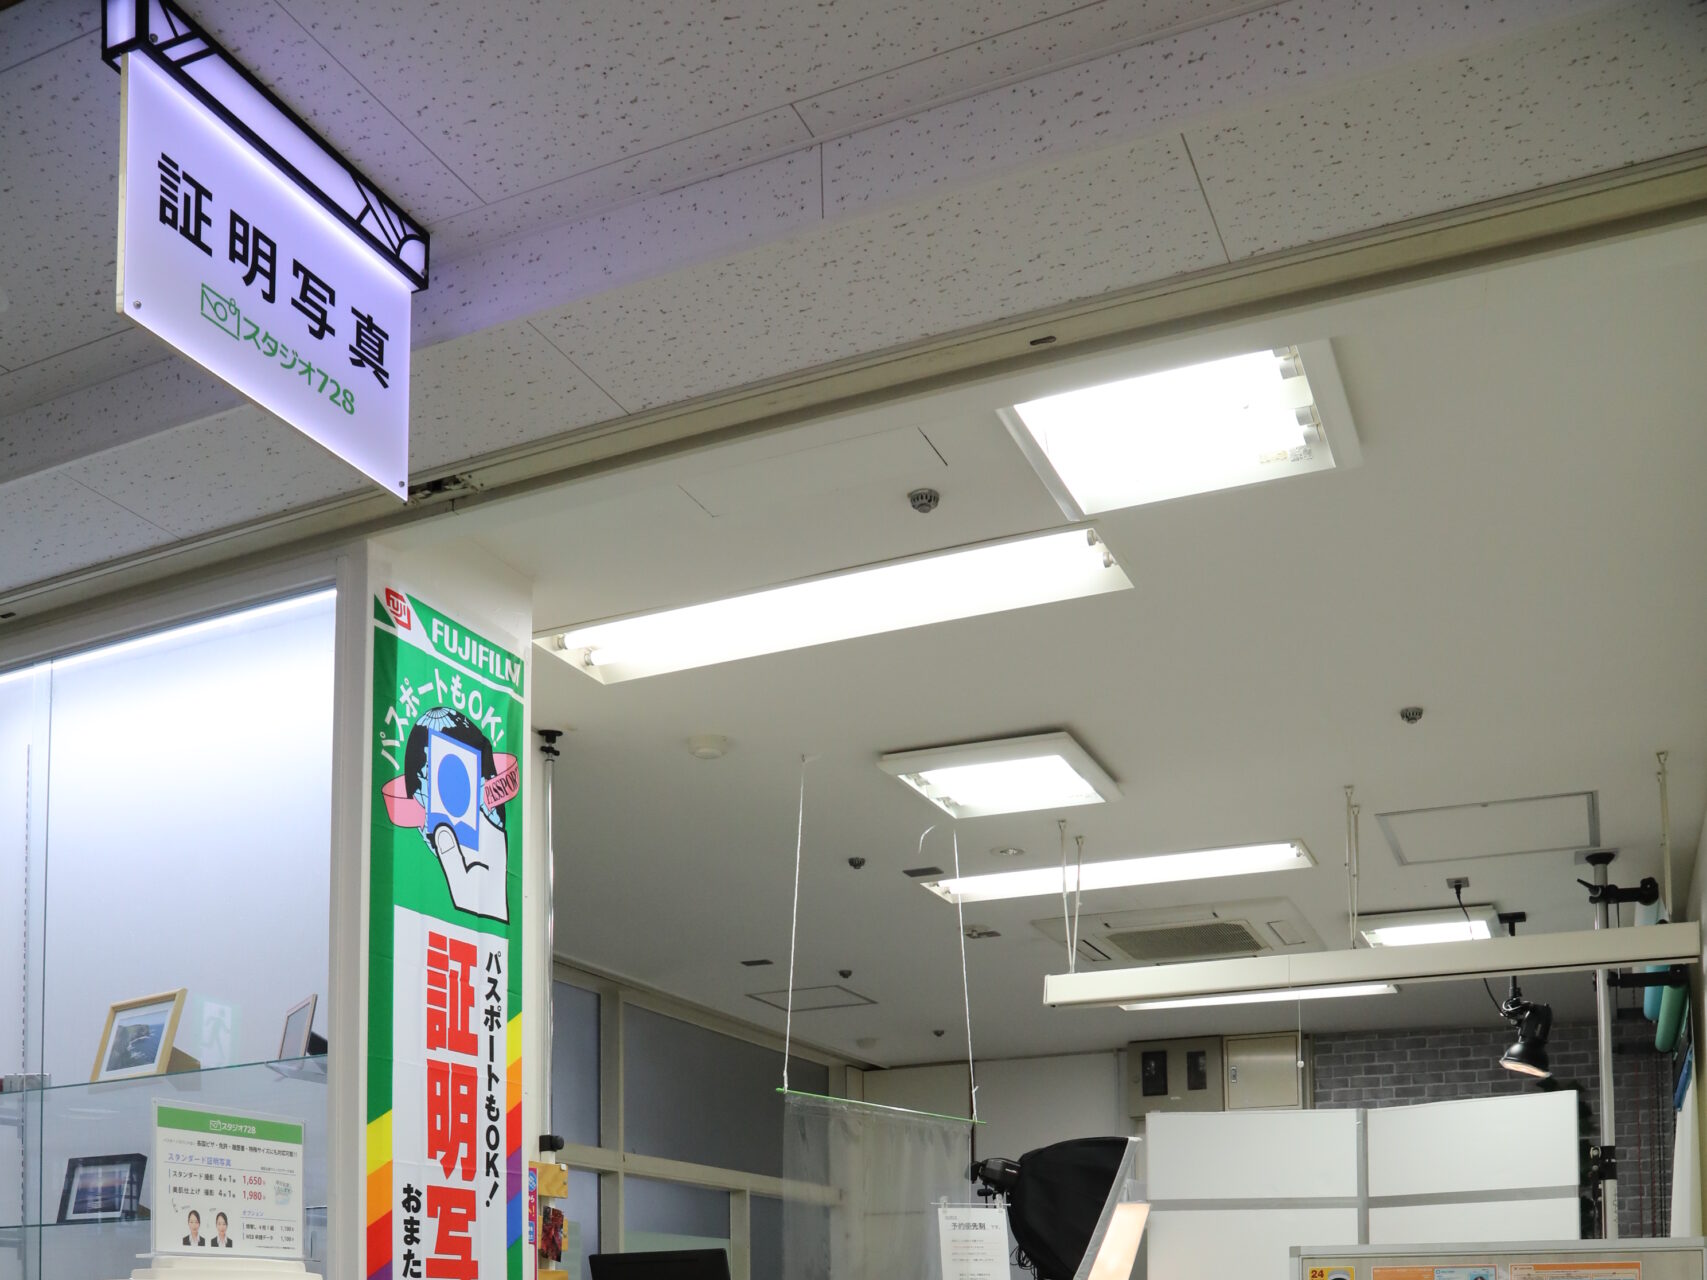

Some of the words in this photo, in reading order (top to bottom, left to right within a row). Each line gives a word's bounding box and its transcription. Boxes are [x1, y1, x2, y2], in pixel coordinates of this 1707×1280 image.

[158, 152, 390, 389] 証明写真
[243, 317, 355, 415] スタジオ728
[432, 617, 520, 687] FUJIFILM
[381, 668, 505, 770] パスポートもOK!
[484, 950, 502, 1207] パスポートもOK!
[1311, 1270, 1324, 1278] 24
